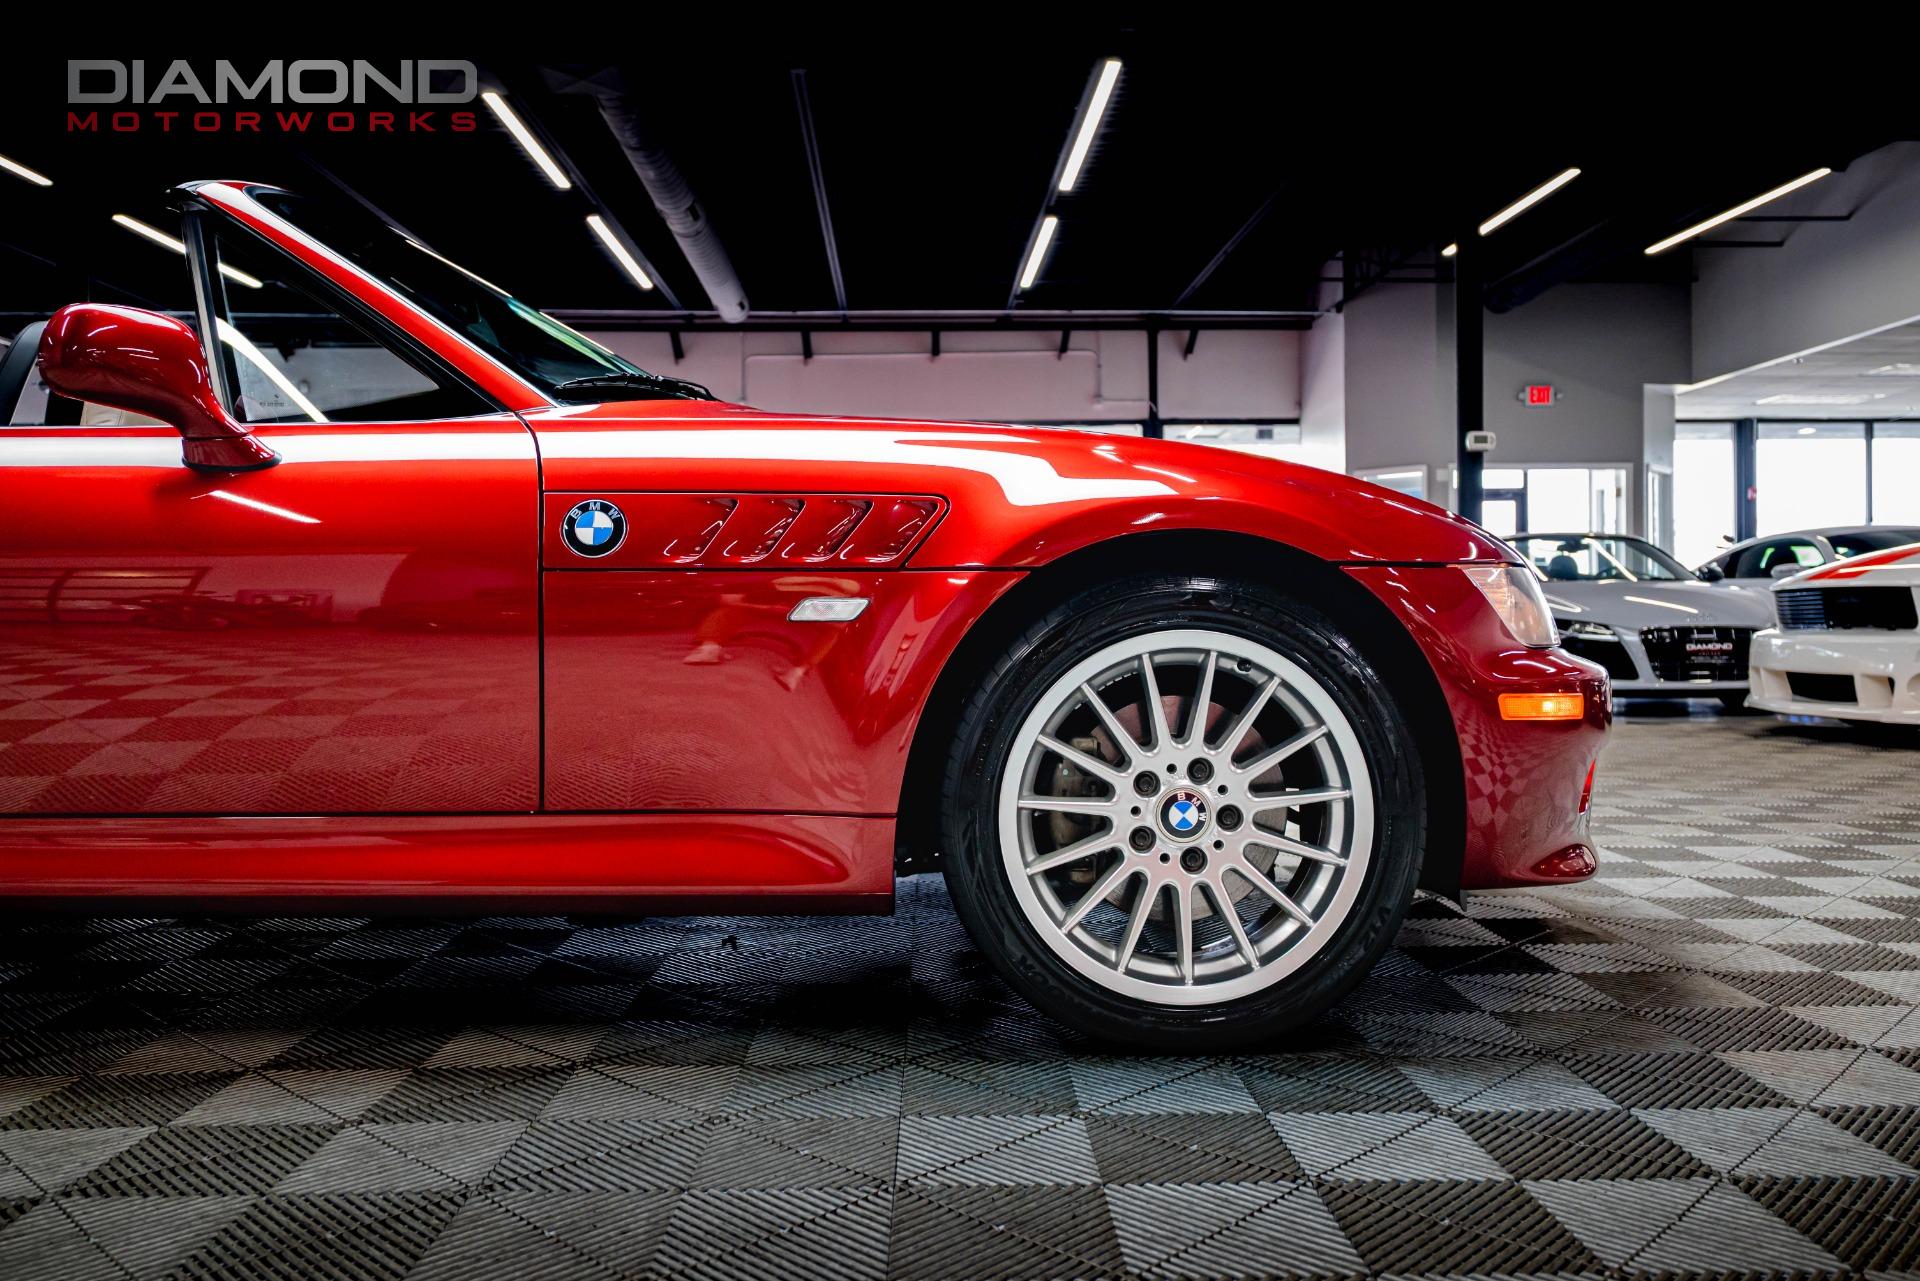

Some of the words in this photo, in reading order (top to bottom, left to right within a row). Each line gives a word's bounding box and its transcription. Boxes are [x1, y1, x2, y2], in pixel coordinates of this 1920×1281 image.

[1529, 385, 1551, 404] EXIT
[570, 501, 621, 520] BMW
[1685, 642, 1733, 651] DIAMOND
[1176, 791, 1207, 822] BMW
